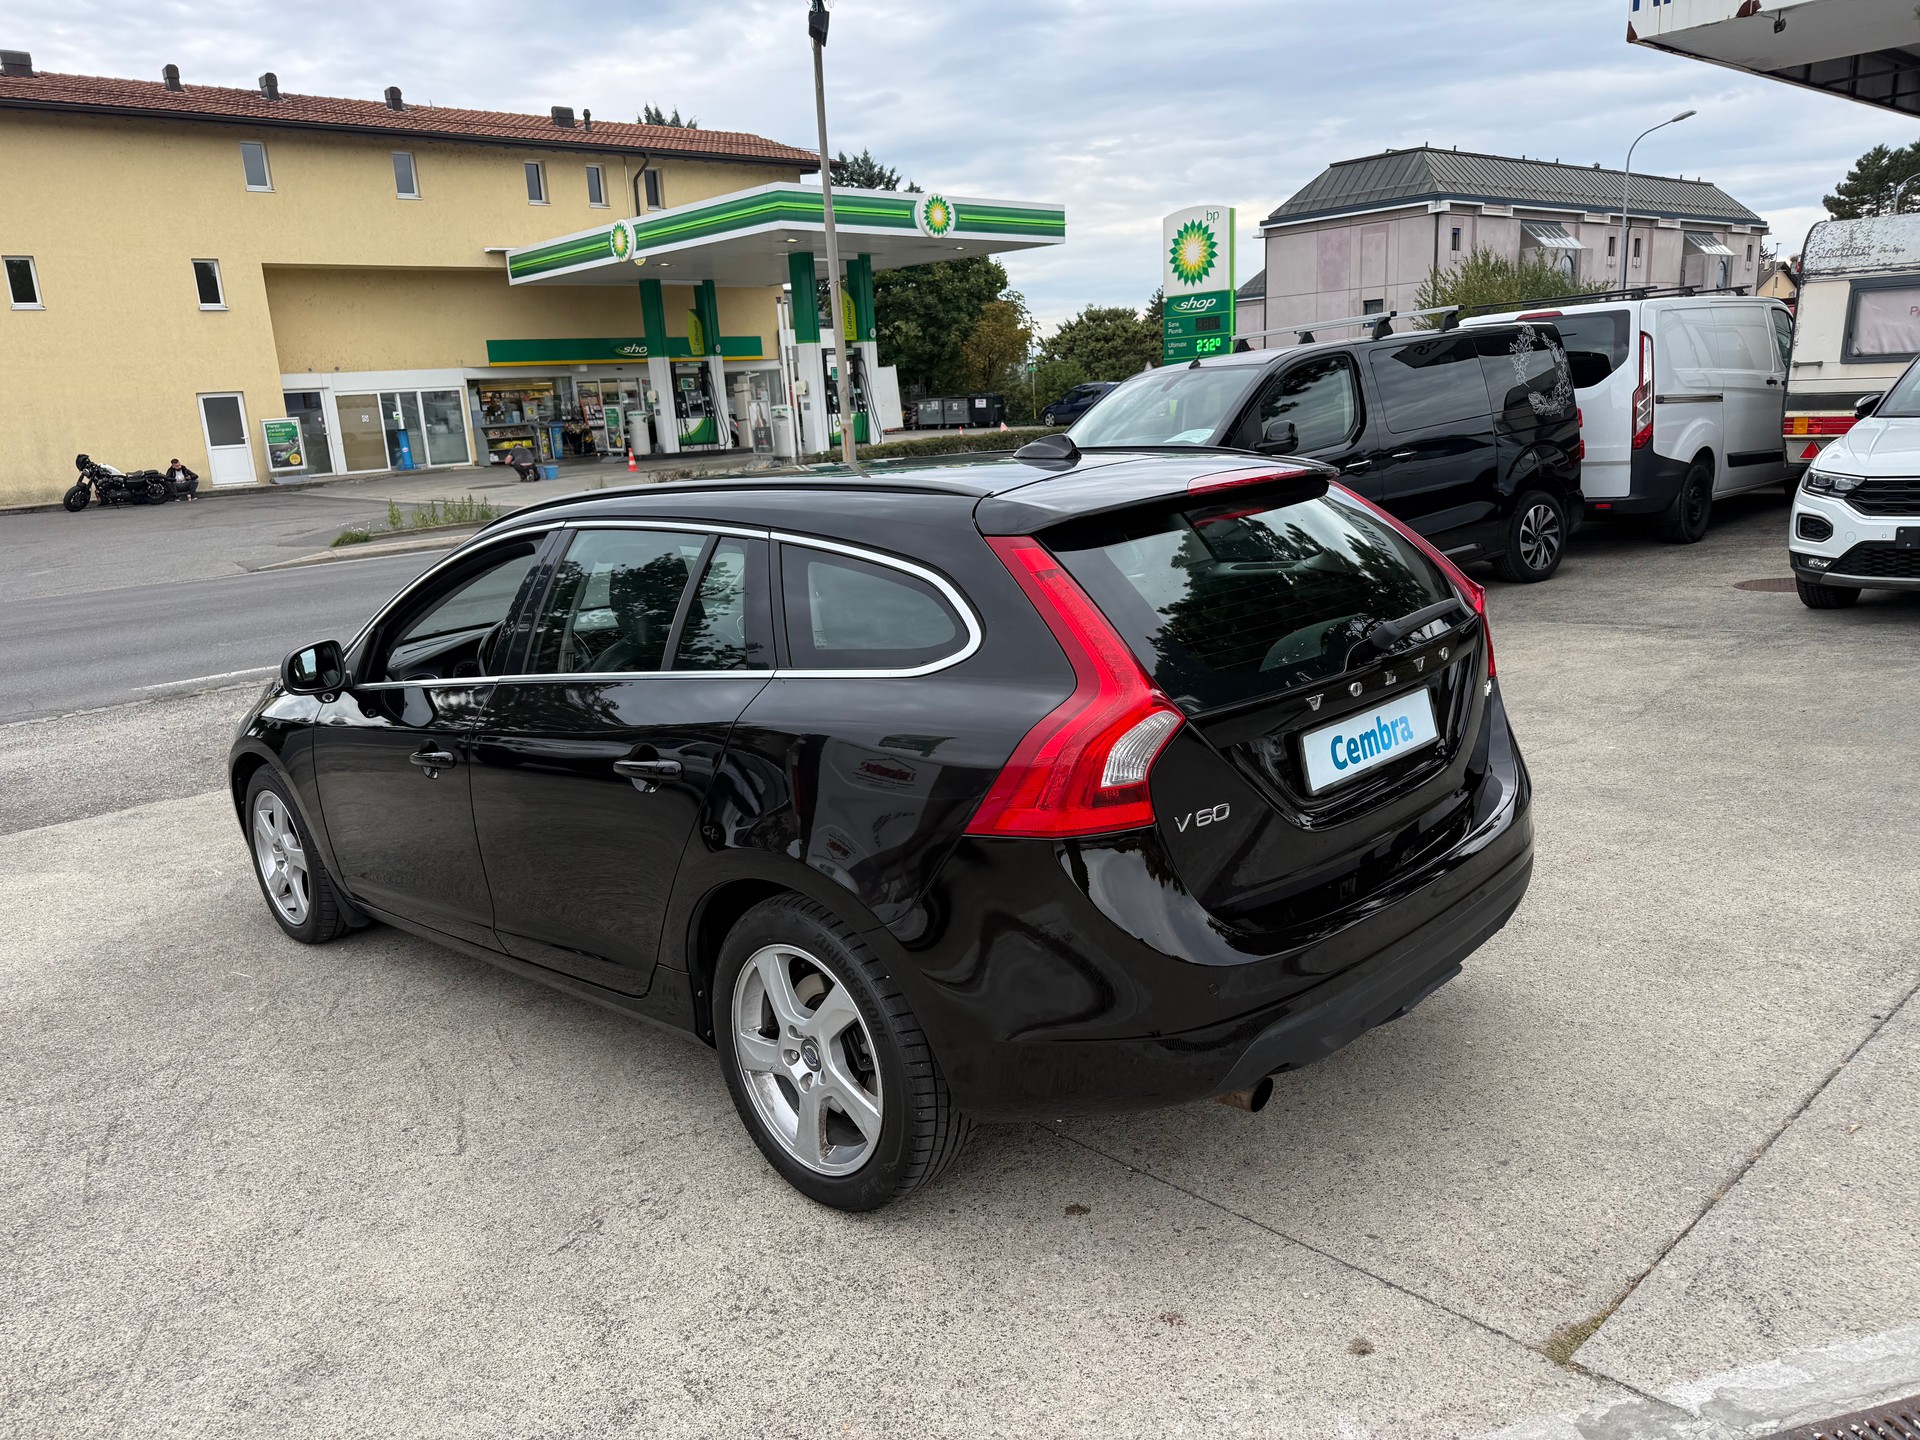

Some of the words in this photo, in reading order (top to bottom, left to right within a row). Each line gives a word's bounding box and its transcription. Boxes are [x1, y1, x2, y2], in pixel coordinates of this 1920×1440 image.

[1206, 210, 1220, 223] bp
[1179, 297, 1217, 311] shop
[624, 343, 648, 355] sho
[1305, 646, 1450, 711] VOLVO
[1331, 714, 1413, 770] Cembra
[1174, 803, 1230, 833] V60
[813, 932, 890, 1042] BRIDGESTONE
